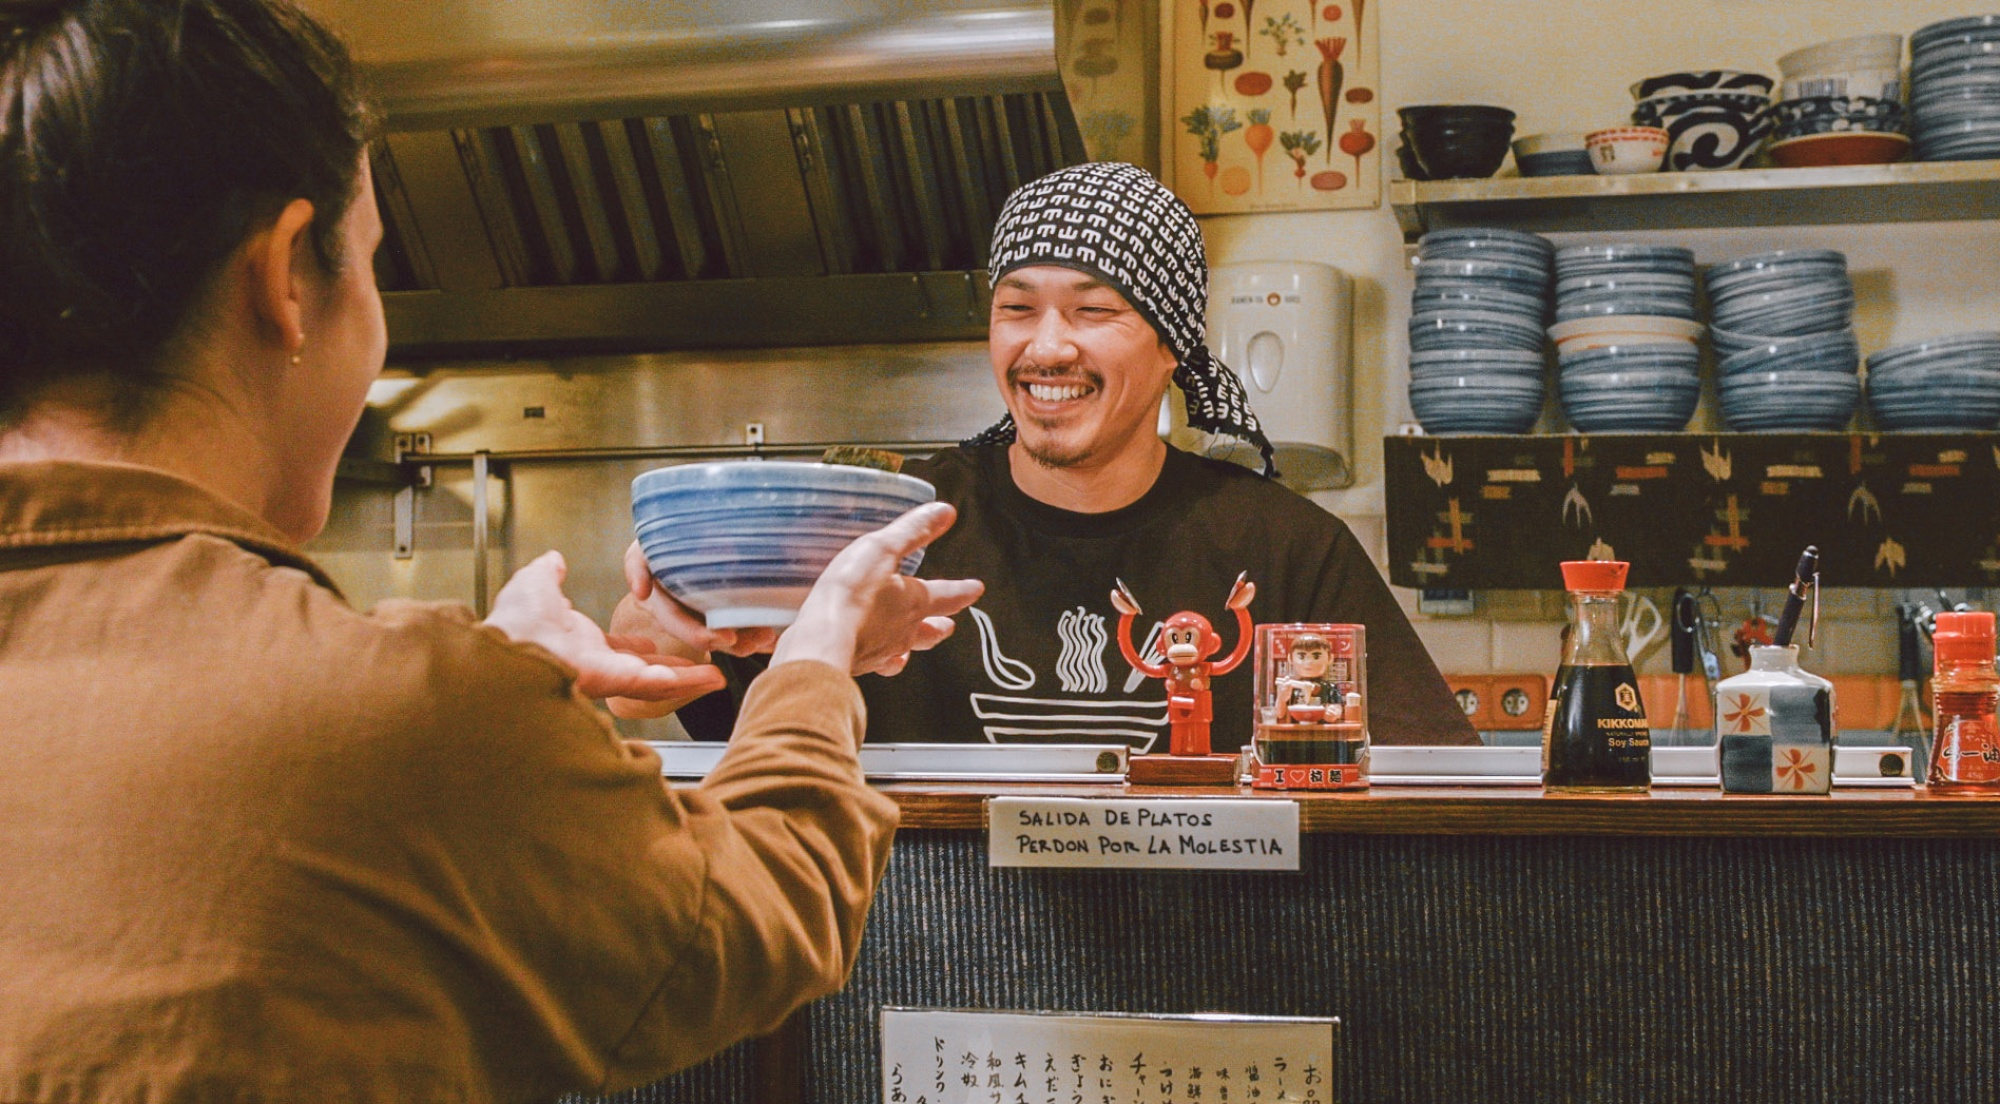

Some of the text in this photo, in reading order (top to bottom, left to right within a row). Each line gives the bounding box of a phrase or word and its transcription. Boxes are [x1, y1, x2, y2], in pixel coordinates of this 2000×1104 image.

[1608, 737, 1627, 749] Soy
[1274, 768, 1285, 784] I
[1018, 808, 1214, 828] SALIDA DE PLATOS
[1016, 834, 1283, 856] PERDON POR LA MOLESTIA
[1129, 1051, 1147, 1104] チャー
[1187, 1065, 1203, 1104] 海鮮
